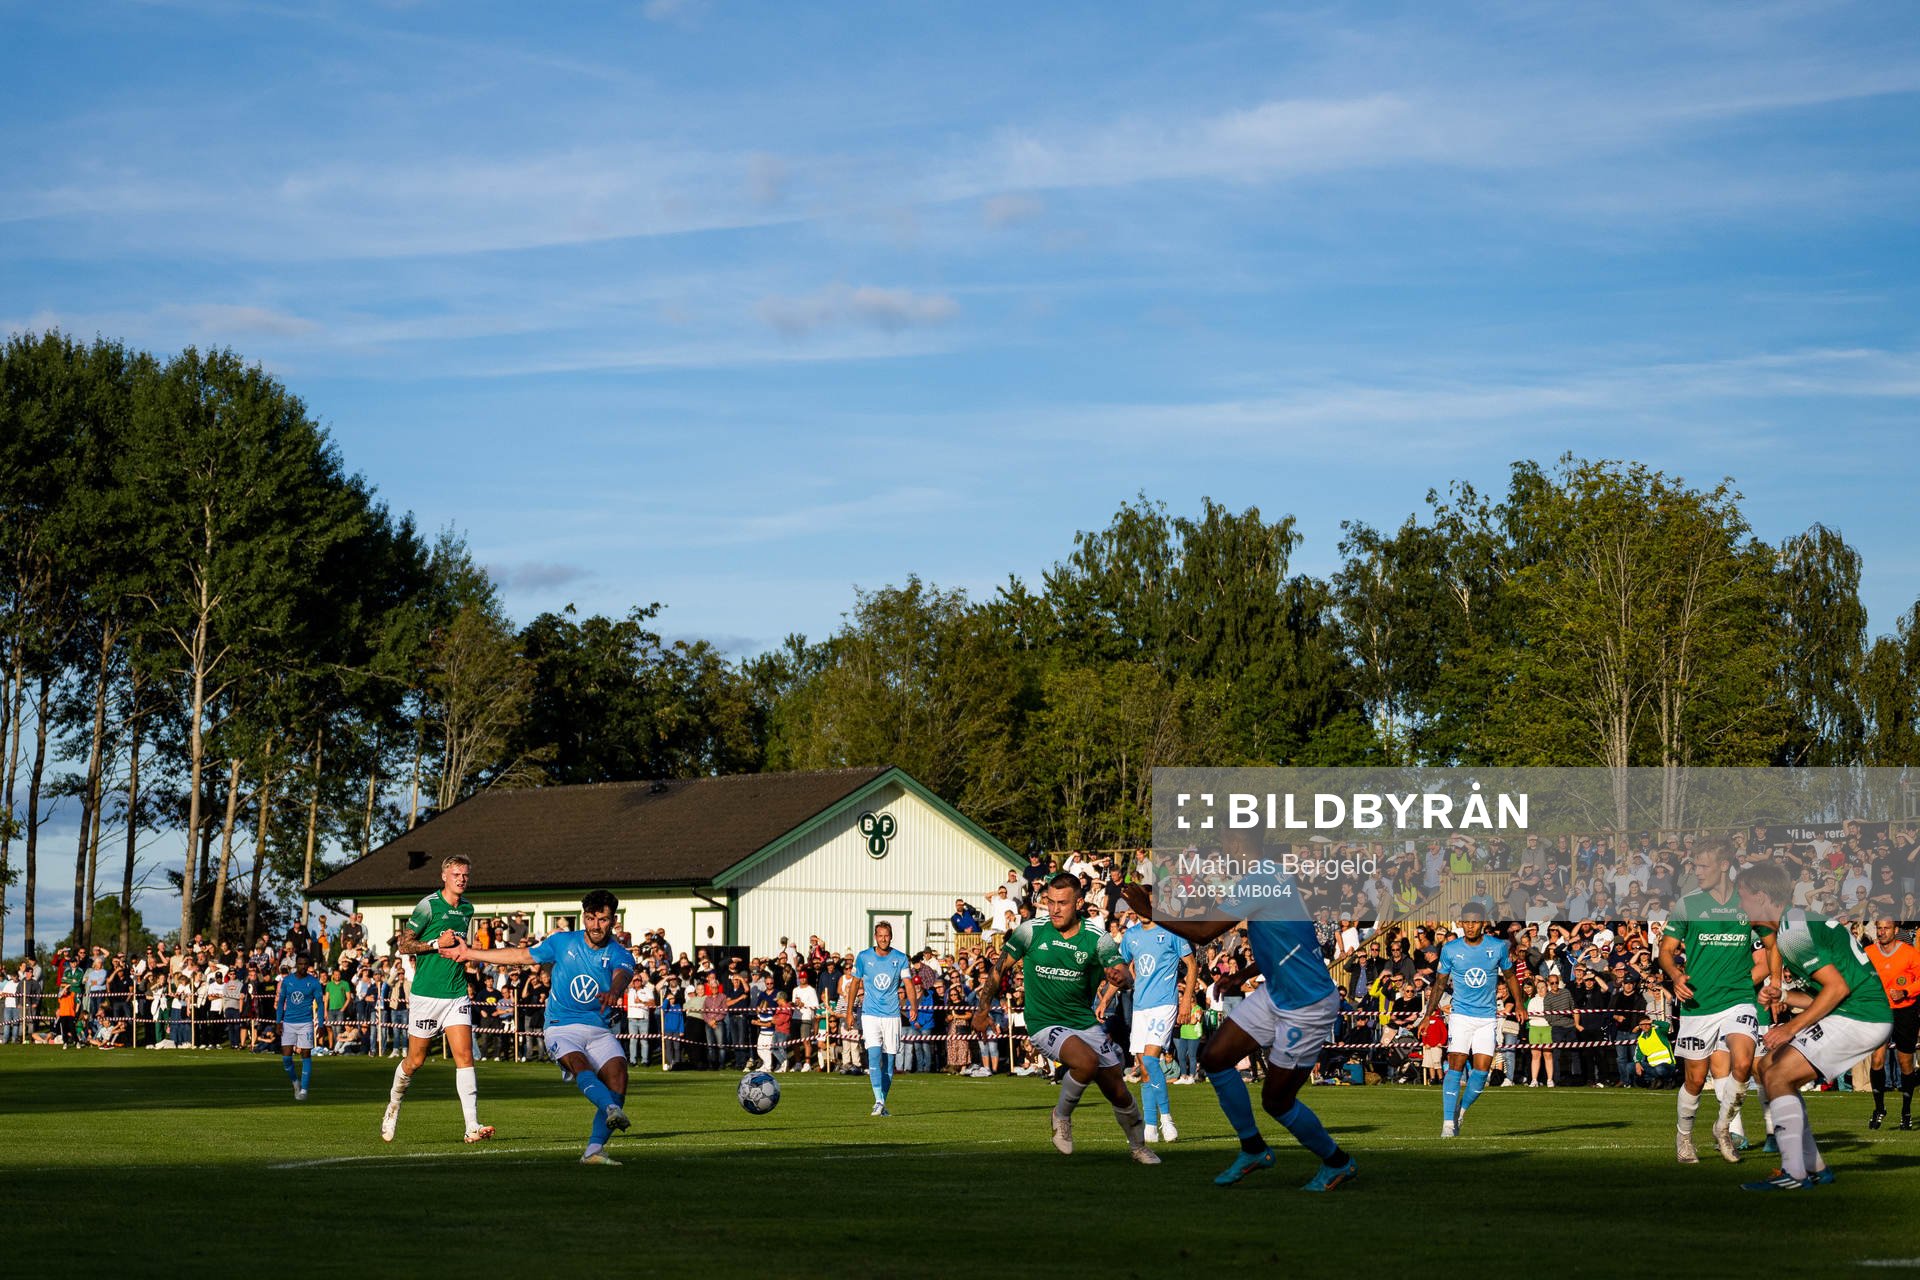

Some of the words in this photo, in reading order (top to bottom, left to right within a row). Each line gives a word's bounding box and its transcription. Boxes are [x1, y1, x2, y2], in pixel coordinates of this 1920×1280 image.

[1052, 940, 1077, 950] stadium
[1753, 940, 1763, 950] C
[1148, 1018, 1165, 1033] 36
[1287, 1027, 1303, 1048] 9
